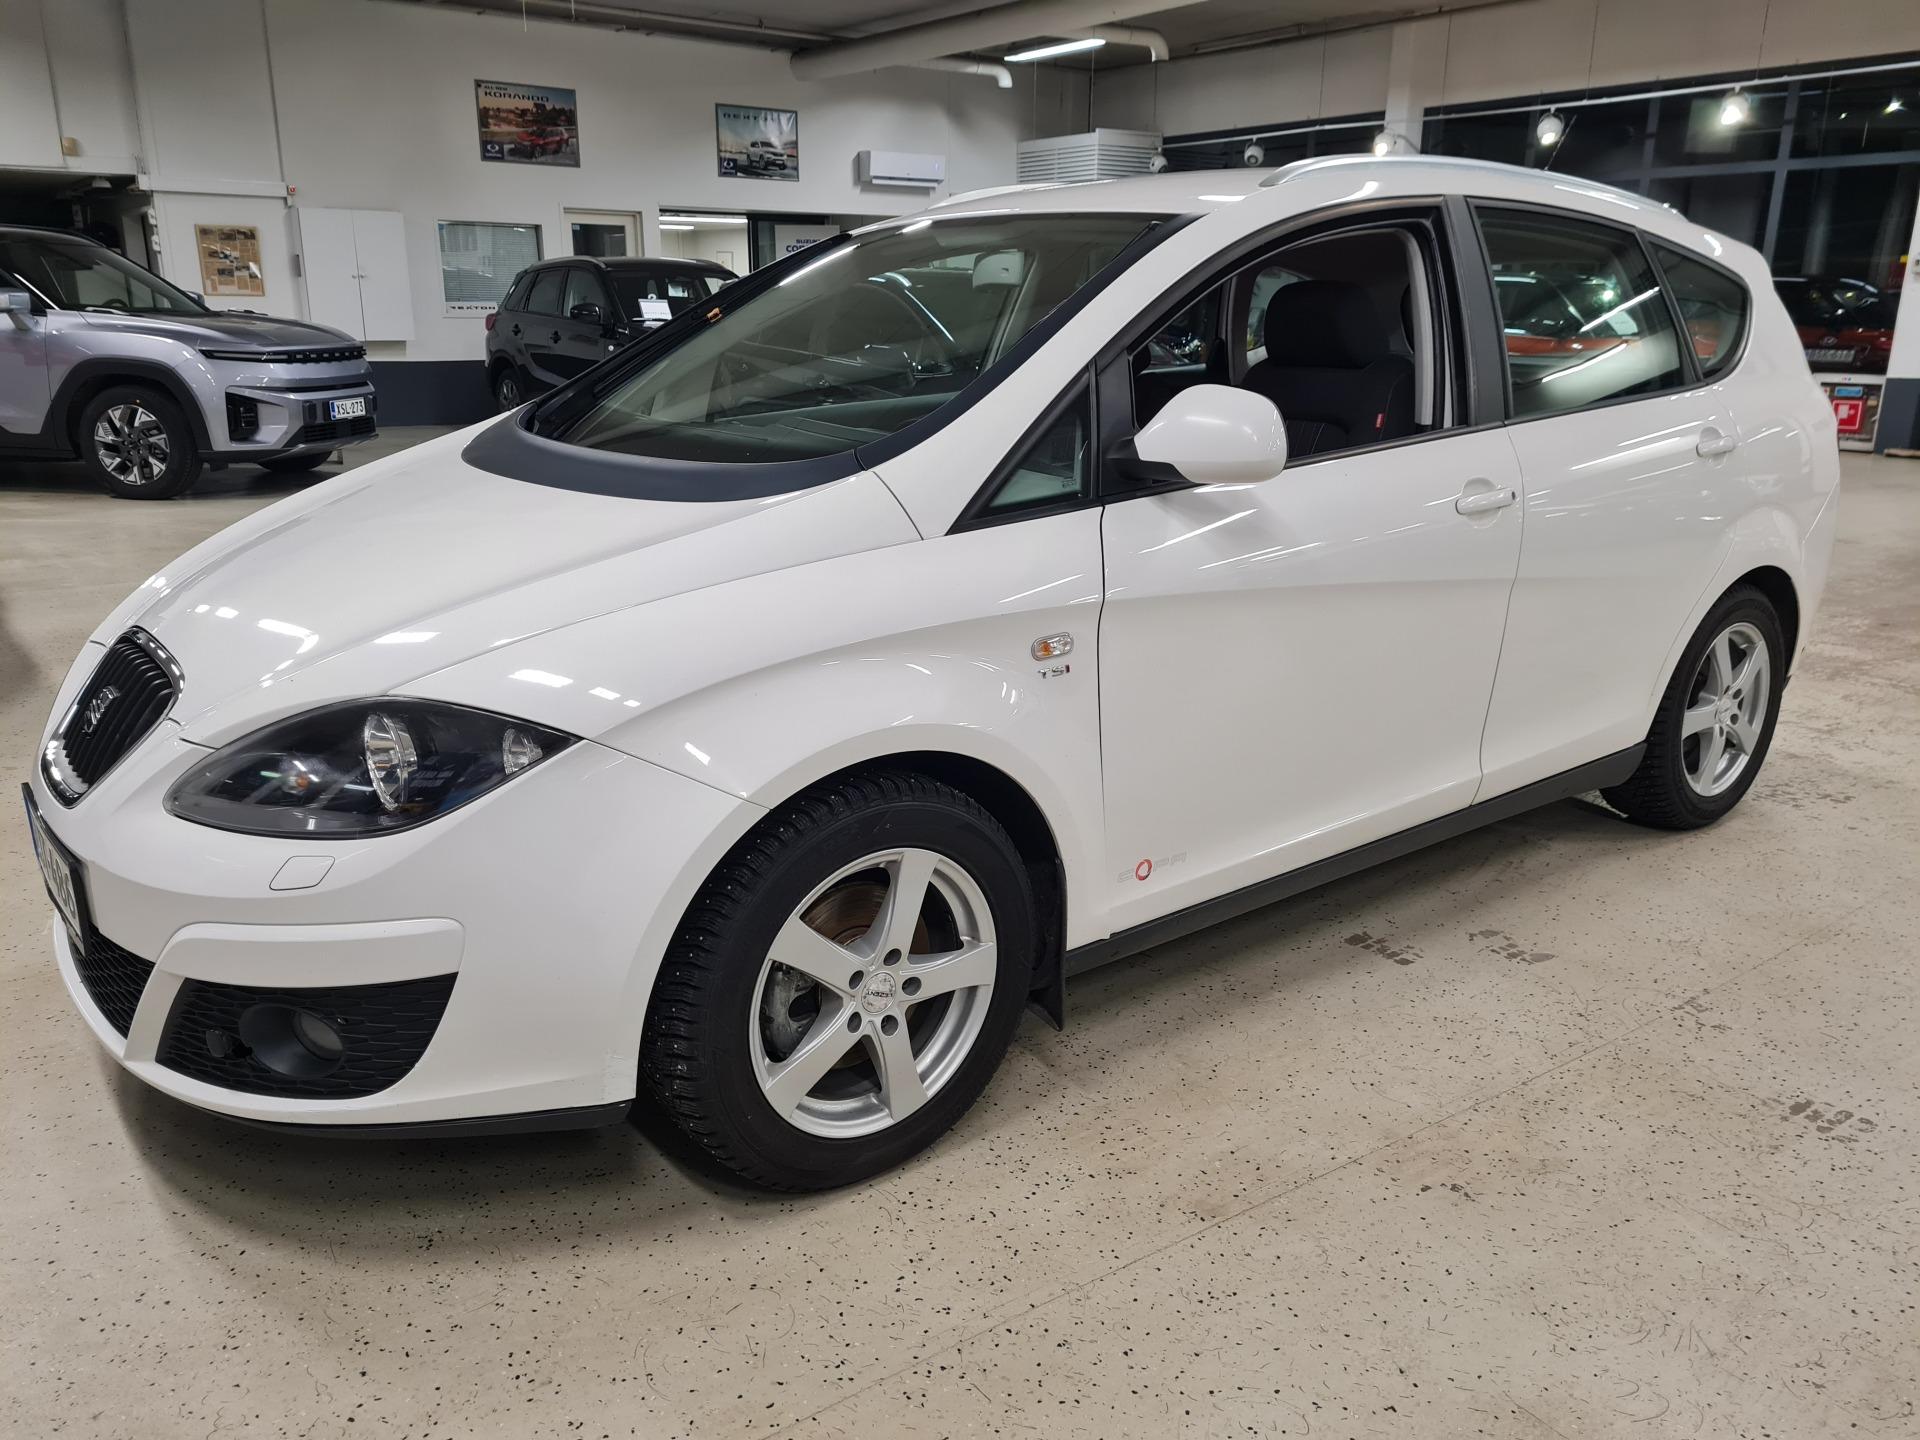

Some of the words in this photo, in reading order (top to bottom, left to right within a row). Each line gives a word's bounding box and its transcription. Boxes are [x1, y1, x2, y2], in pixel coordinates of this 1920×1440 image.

[484, 91, 549, 102] KORANDO
[336, 401, 364, 415] XSL-273
[1037, 664, 1070, 679] TSI
